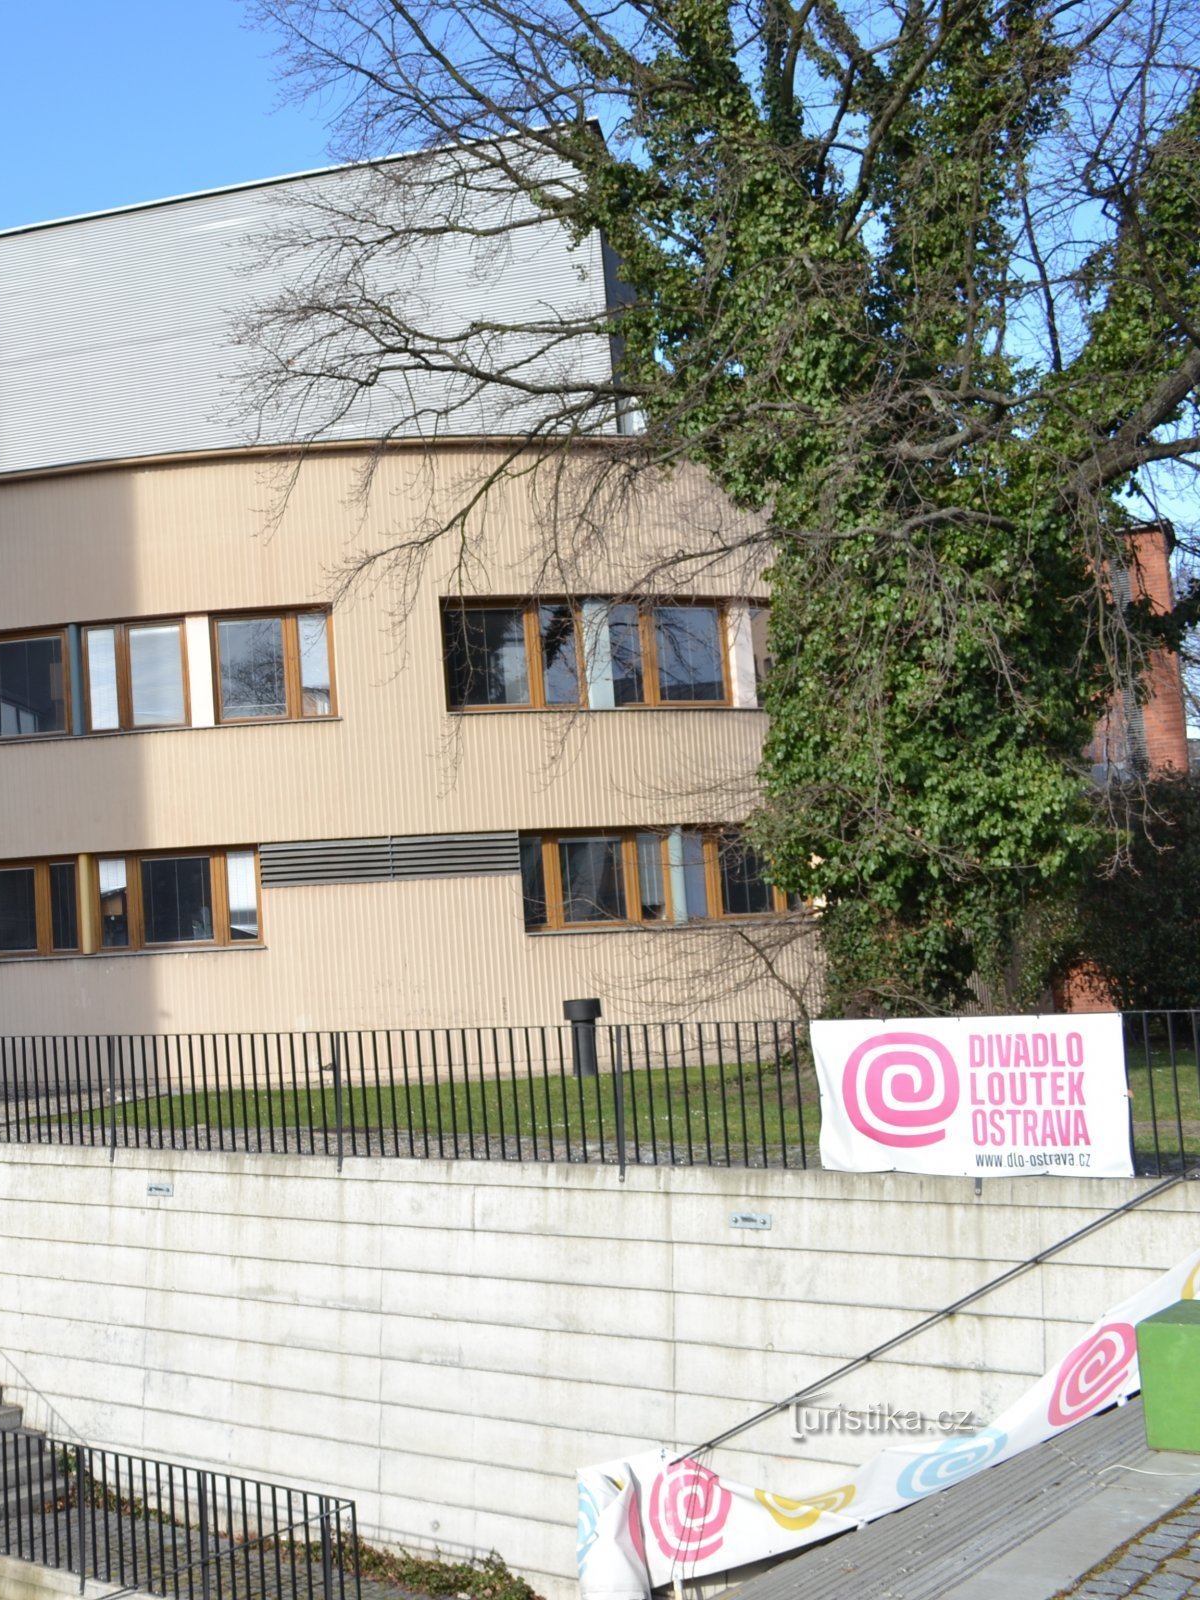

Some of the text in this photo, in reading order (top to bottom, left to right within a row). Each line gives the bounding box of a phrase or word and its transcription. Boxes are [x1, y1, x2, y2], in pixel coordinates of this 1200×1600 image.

[969, 1031, 1084, 1068] DIVADLO
[969, 1071, 1087, 1106] LOUTEK
[971, 1109, 1092, 1147] OSTRAVA
[975, 1152, 1092, 1168] www.dlo-ostrava.cz
